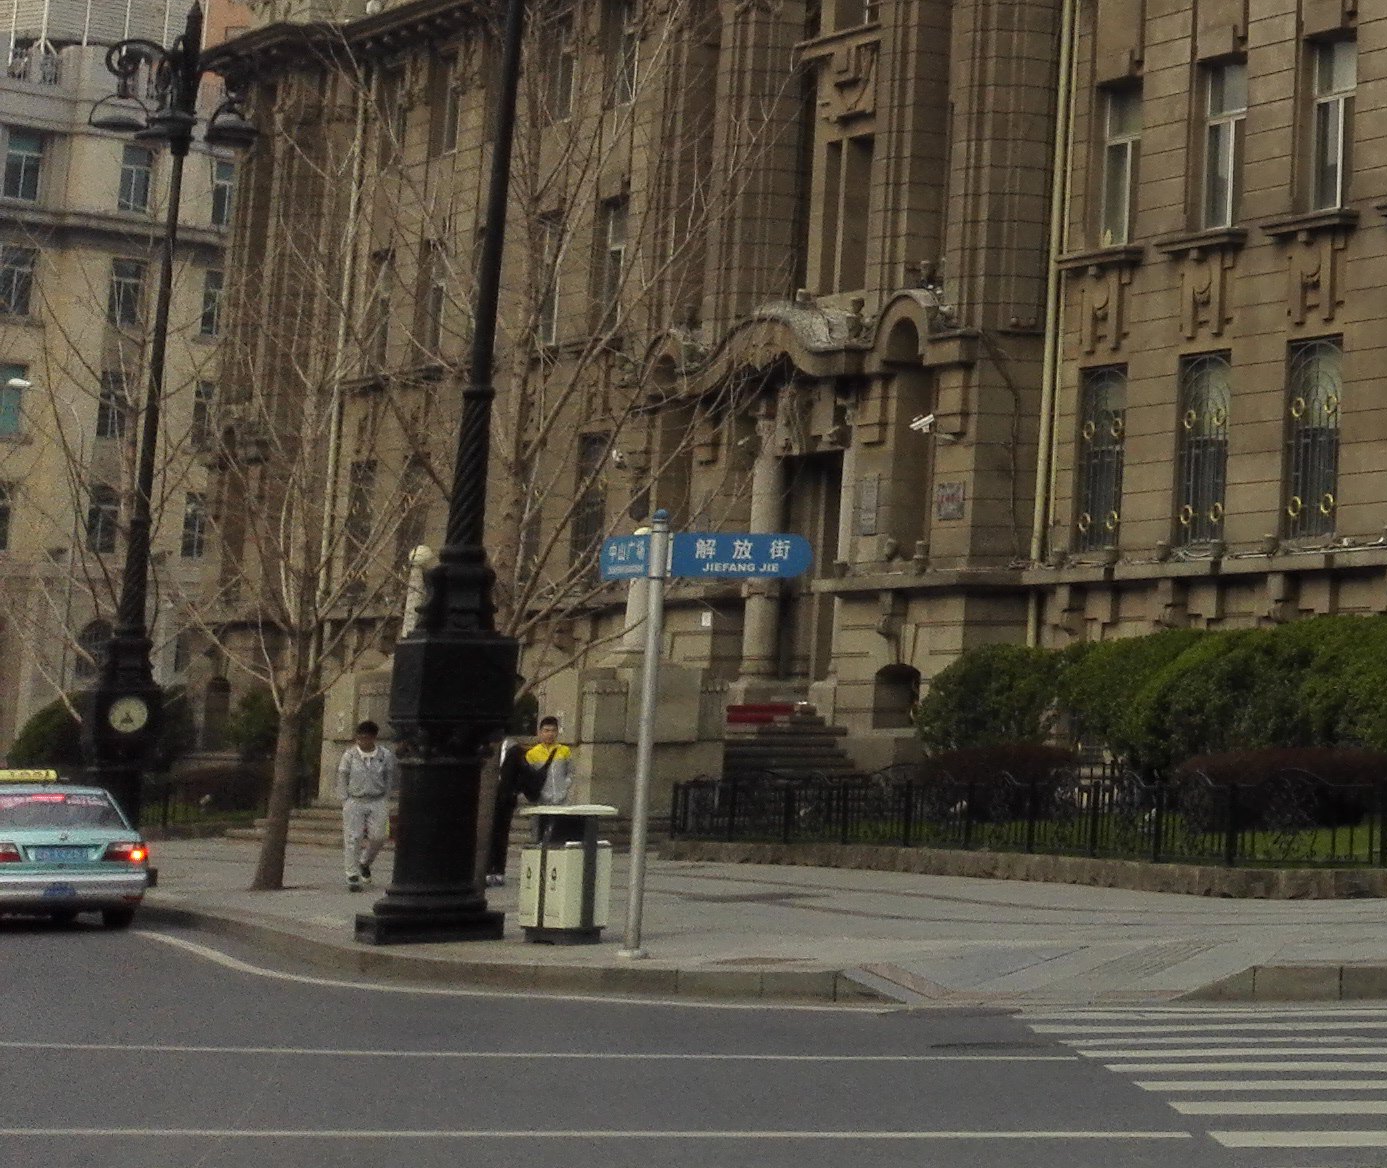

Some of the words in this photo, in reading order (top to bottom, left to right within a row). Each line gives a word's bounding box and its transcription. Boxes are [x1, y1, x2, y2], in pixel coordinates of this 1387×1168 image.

[695, 538, 791, 560] 解放街
[702, 562, 756, 573] JIEFANG
[759, 562, 780, 573] JIE
